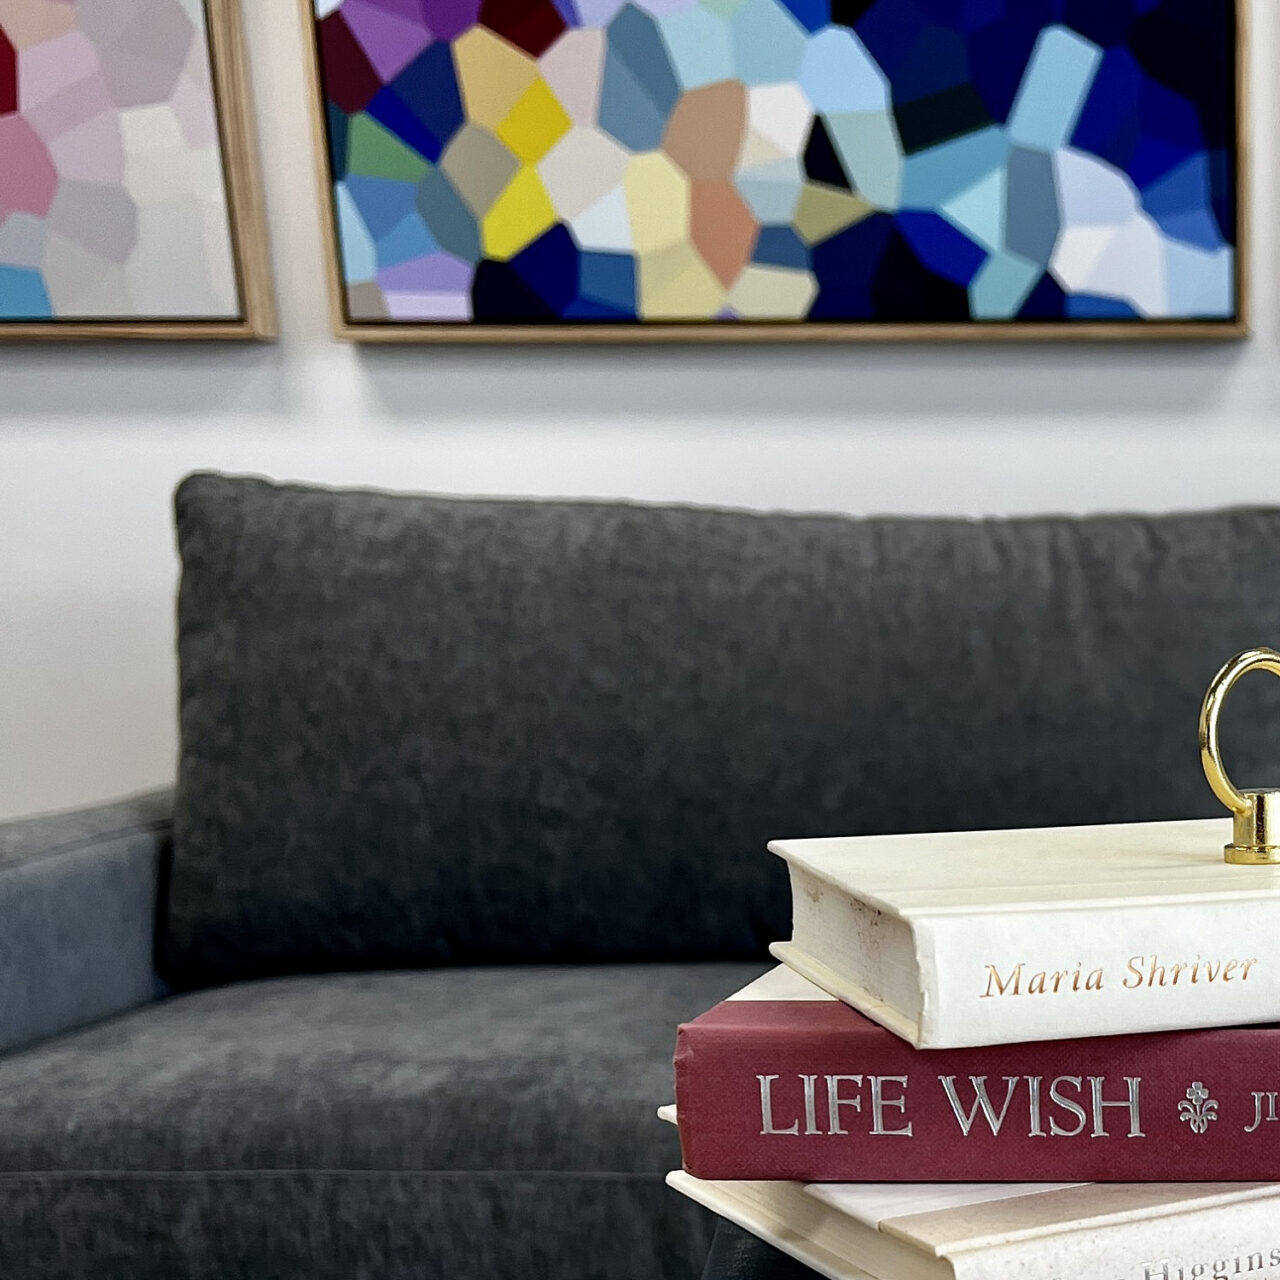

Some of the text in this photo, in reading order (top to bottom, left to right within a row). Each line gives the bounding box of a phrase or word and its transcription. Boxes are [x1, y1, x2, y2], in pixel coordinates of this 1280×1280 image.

[980, 954, 1258, 998] Maria Shriver
[755, 1074, 1146, 1138] LIFE WISH
